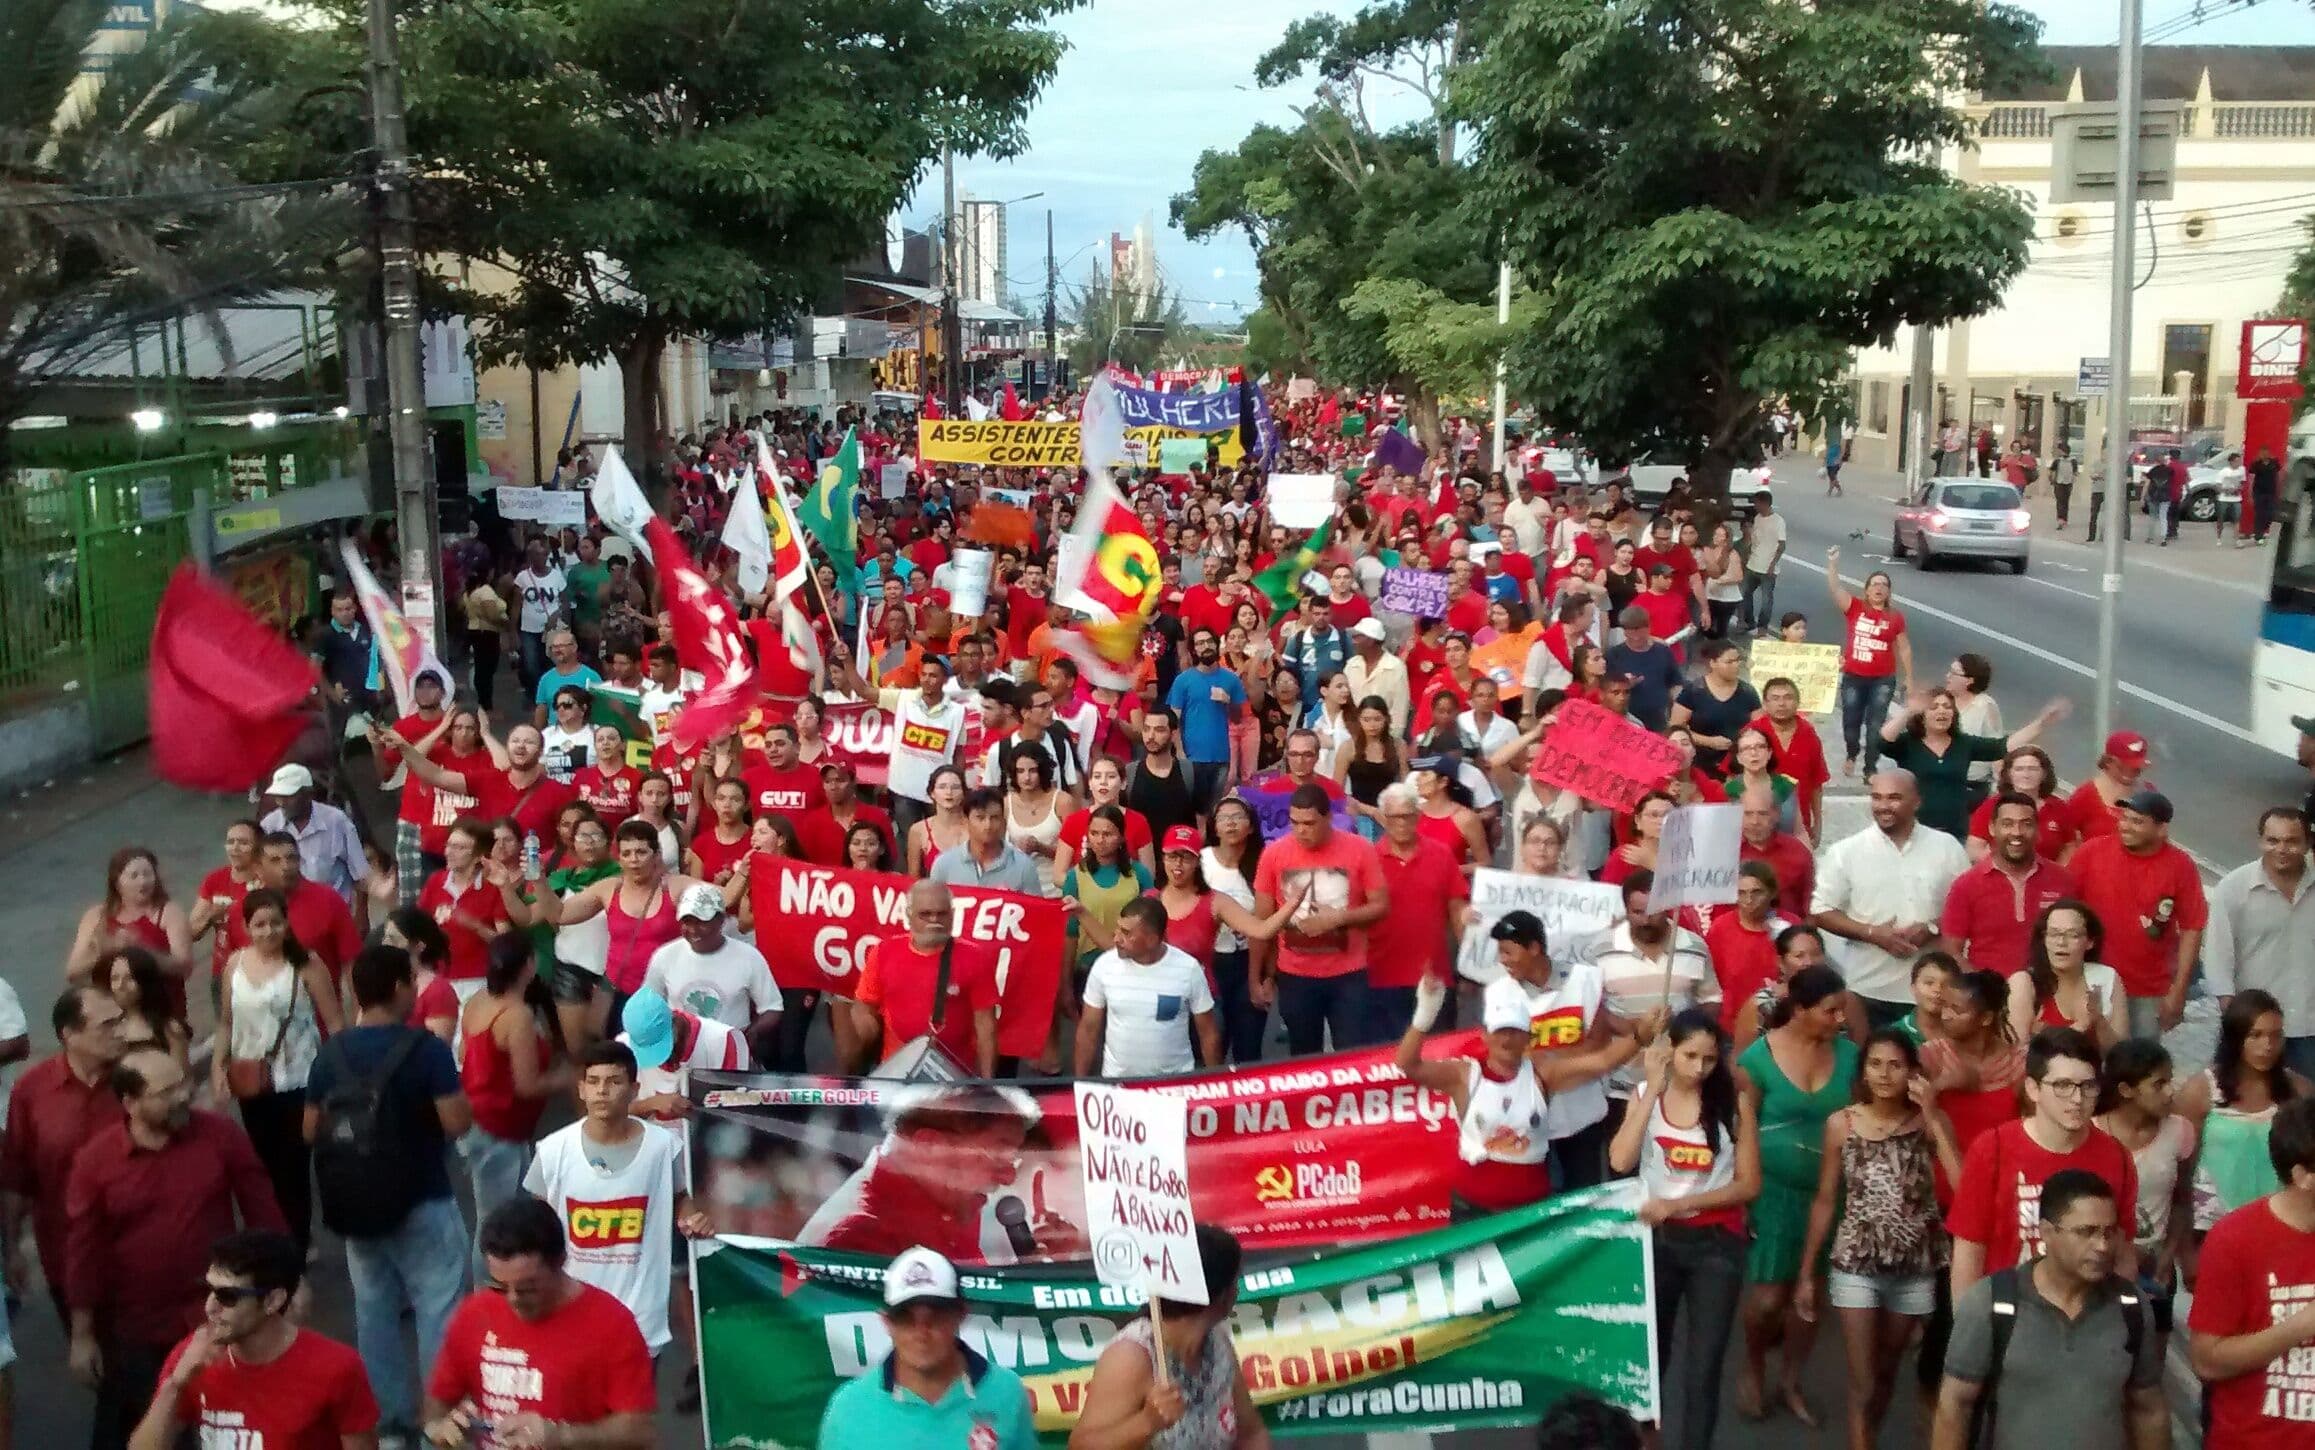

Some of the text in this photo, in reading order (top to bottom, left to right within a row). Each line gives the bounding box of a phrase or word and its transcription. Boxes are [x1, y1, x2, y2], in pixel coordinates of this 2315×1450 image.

[929, 423, 1082, 445] ASSISTENTES
[988, 445, 1082, 463] CONTR
[904, 724, 946, 750] CTB
[760, 791, 805, 808] CUT
[779, 867, 1030, 942] NÃO VA TER
[1233, 1077, 1266, 1096] NO
[1269, 1072, 1329, 1092] RABO
[1332, 1068, 1363, 1086] DA
[1233, 1099, 1291, 1134] NA
[1304, 1084, 1458, 1132] CABEÇ
[1087, 1143, 1131, 1187] NÃO
[1670, 1145, 1713, 1166] CTB
[1296, 1160, 1361, 1199] PCdoB
[571, 1206, 645, 1239] CTB
[1032, 1285, 1092, 1309] Em
[1241, 1335, 1417, 1392] Golpe!
[1277, 1377, 1524, 1421] #ForaCunha
